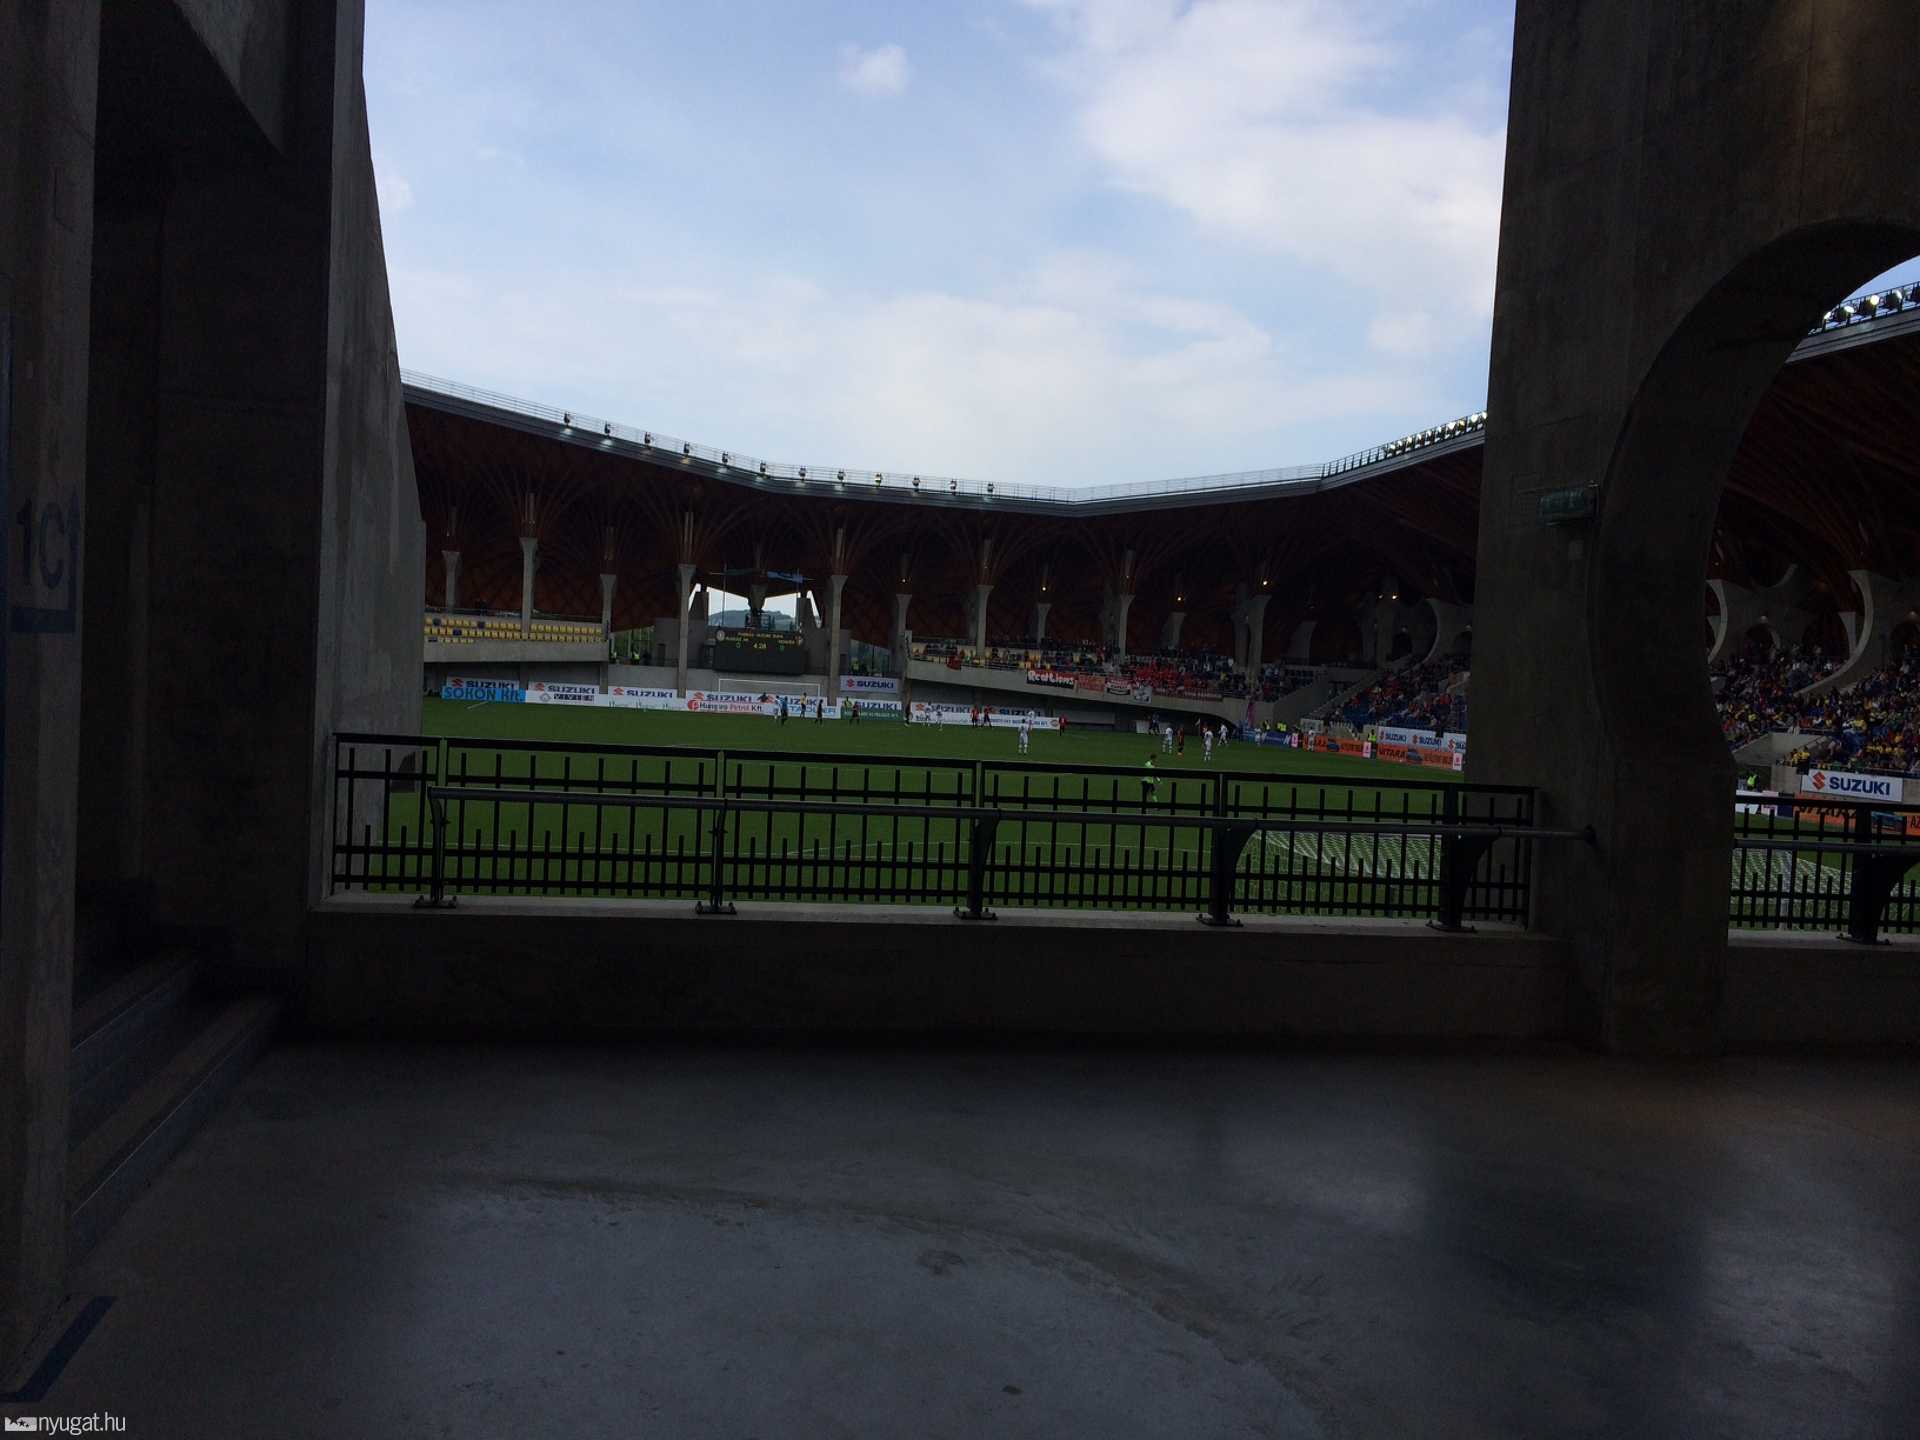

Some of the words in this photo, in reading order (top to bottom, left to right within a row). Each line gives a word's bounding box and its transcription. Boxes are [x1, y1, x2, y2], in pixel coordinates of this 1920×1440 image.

[466, 680, 515, 689] SUZUKI
[857, 680, 894, 689] SUZUKI
[548, 685, 595, 694] SUZUKI
[626, 690, 673, 698] SUZUKI
[706, 694, 752, 703] SUZUKI
[1829, 776, 1890, 795] SUZUKI
